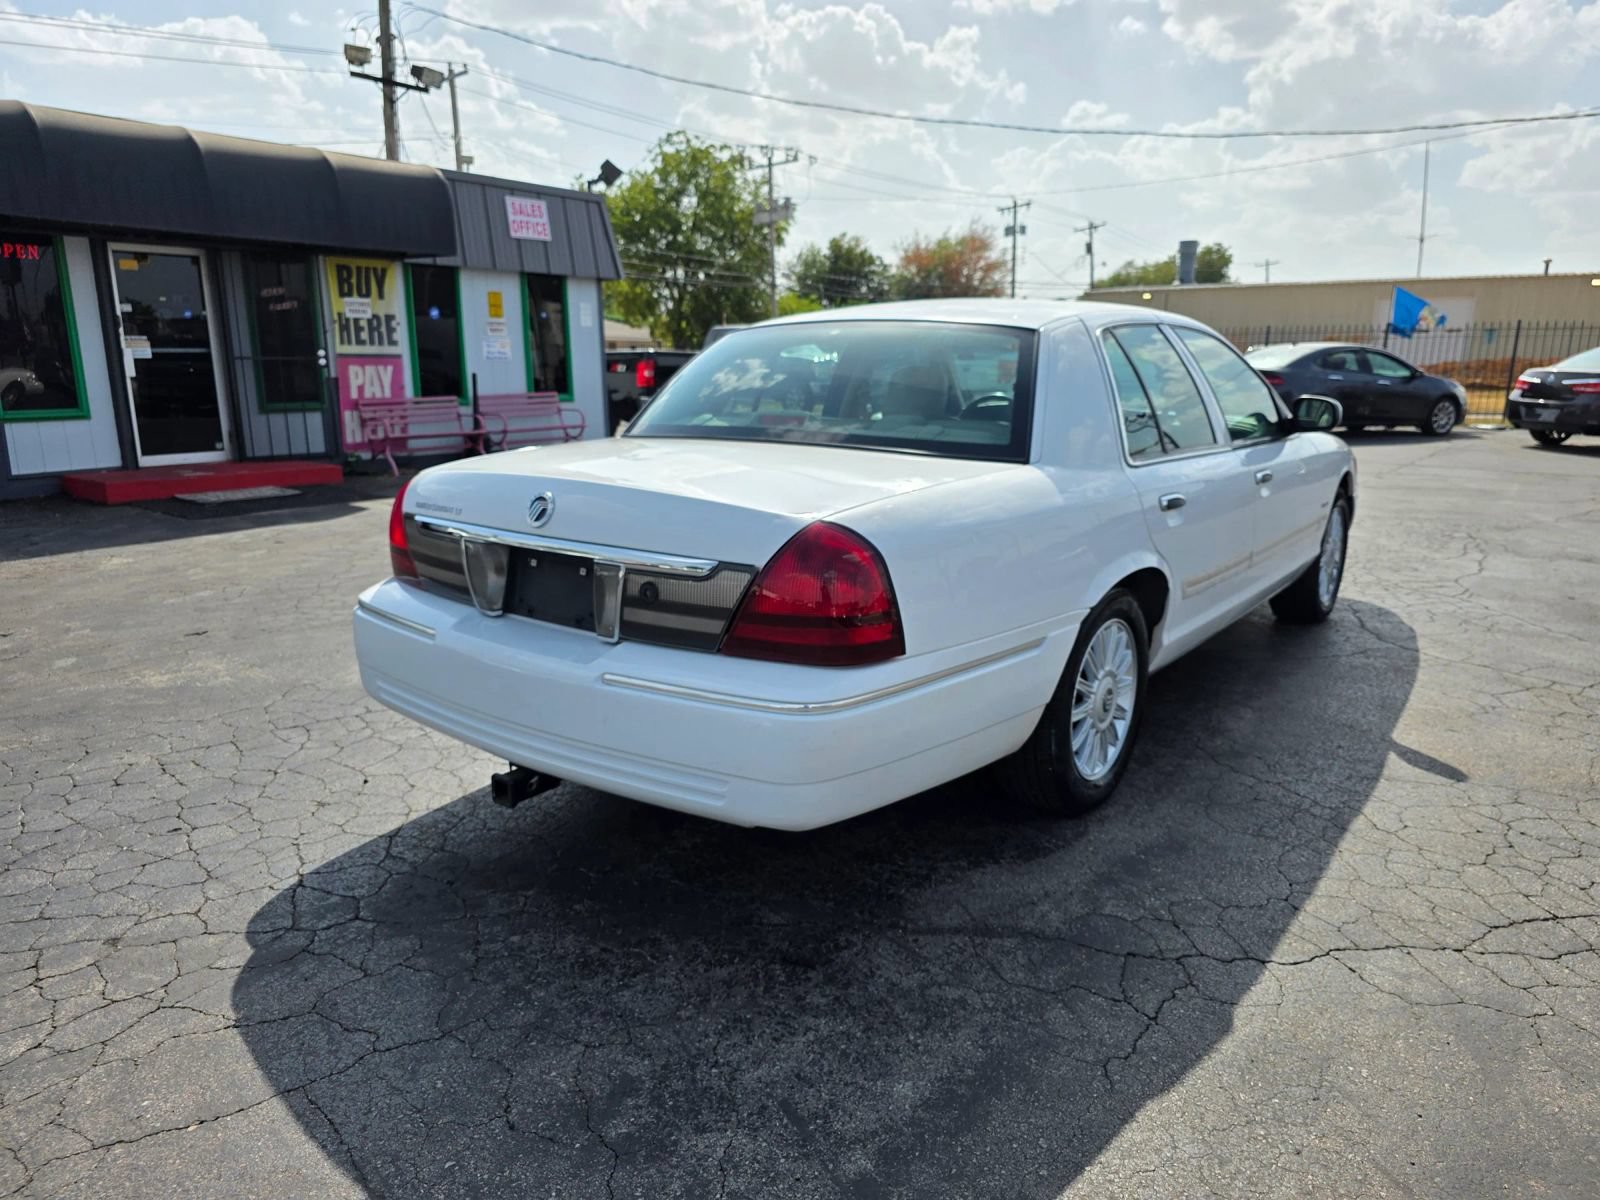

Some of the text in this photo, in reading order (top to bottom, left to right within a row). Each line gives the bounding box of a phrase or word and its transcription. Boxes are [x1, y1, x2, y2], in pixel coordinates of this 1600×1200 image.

[511, 201, 544, 218] SALES
[512, 220, 549, 239] OFFICE
[0, 243, 40, 260] PEN
[336, 264, 388, 300] BUY
[337, 312, 399, 346] HERE
[348, 365, 393, 399] PAY
